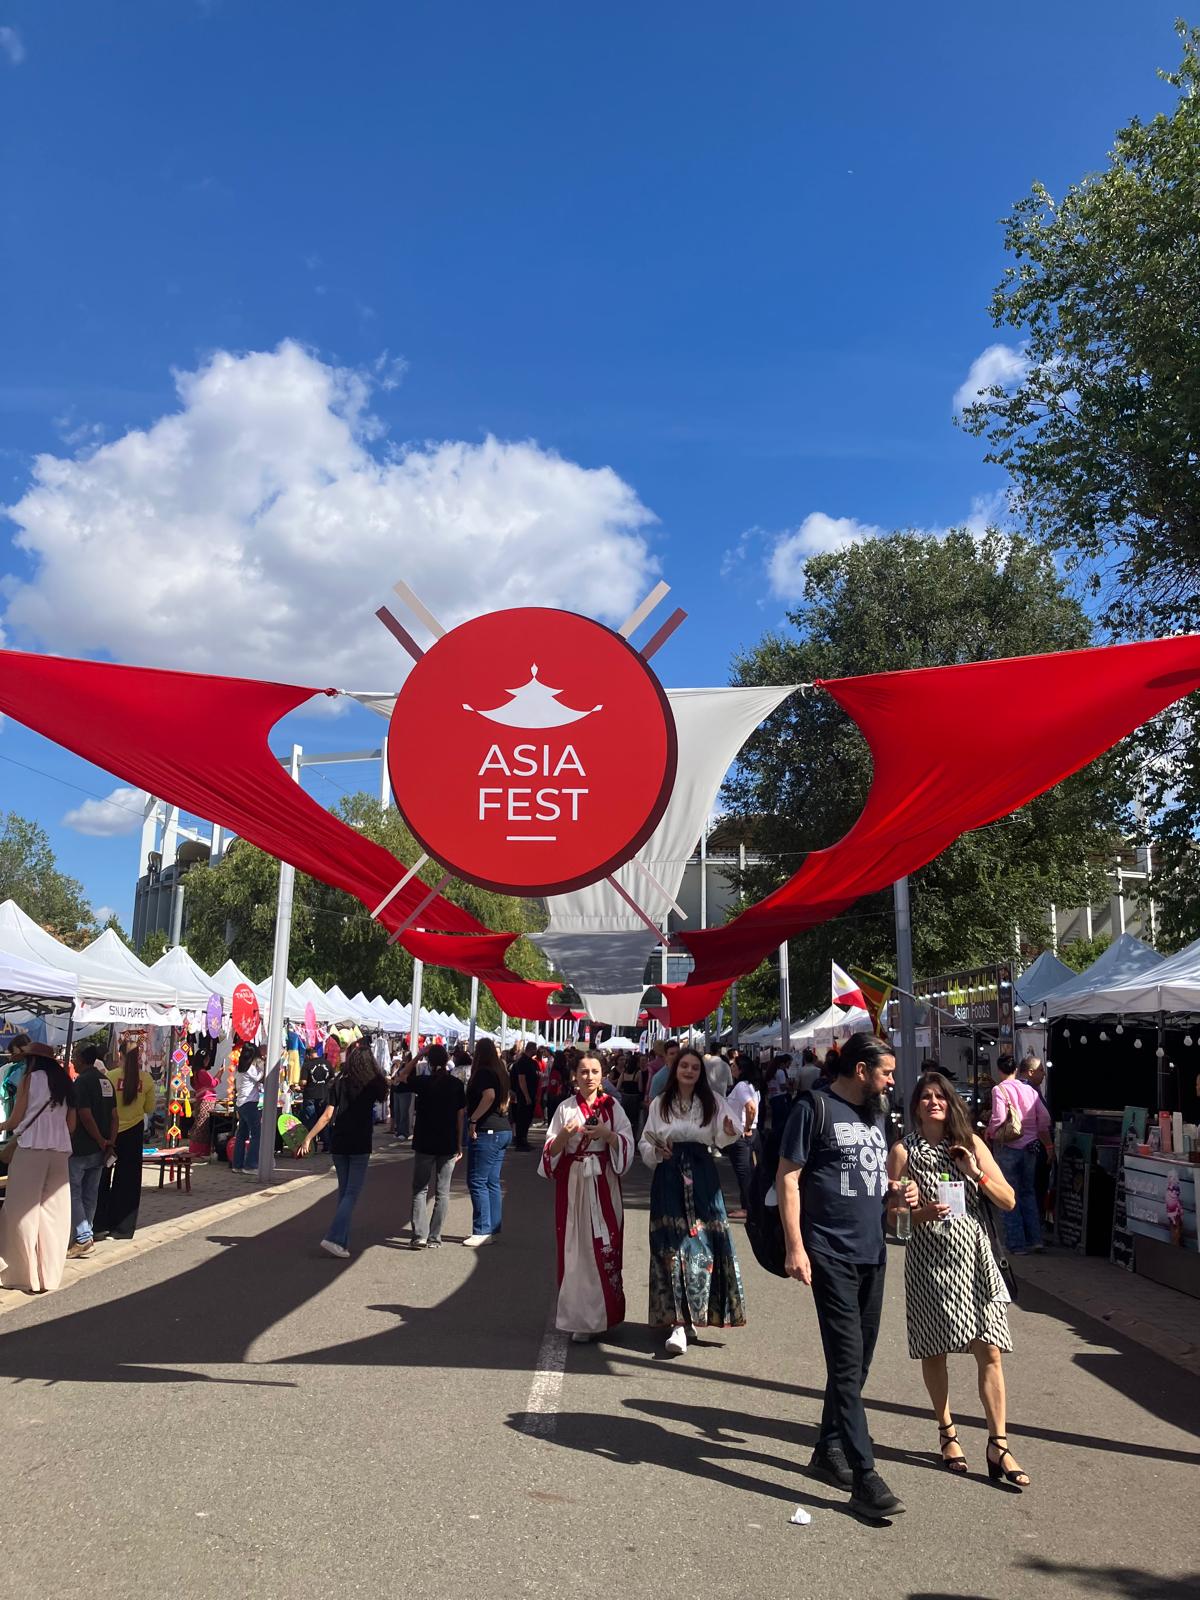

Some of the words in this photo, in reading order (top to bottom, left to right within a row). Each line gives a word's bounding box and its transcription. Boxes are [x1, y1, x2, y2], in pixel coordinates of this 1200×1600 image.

[477, 744, 587, 777] ASIA
[479, 788, 589, 821] FEST
[127, 1007, 149, 1018] PUPPET
[954, 1004, 970, 1019] Asian
[971, 1003, 990, 1018] Foods
[833, 1122, 885, 1148] BRO
